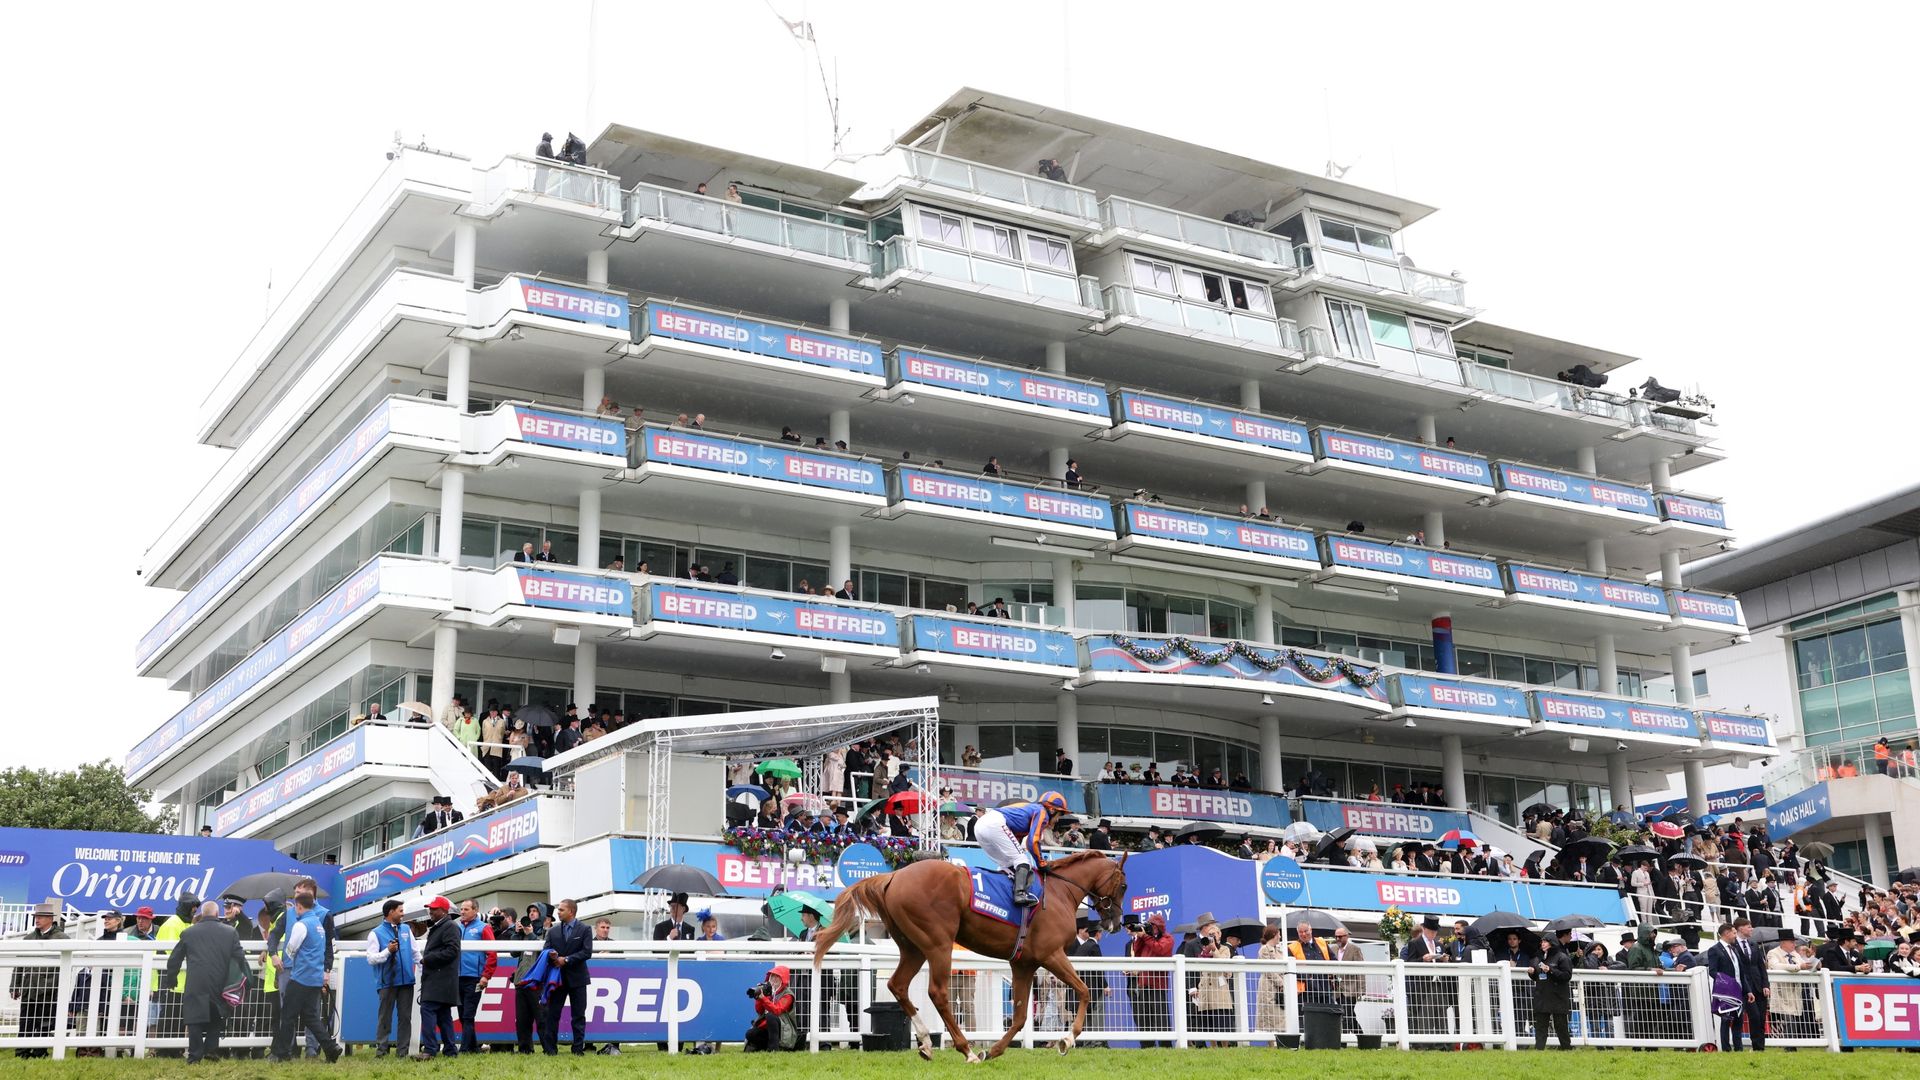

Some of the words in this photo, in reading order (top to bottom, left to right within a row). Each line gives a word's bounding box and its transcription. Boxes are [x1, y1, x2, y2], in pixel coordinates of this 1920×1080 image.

[527, 288, 621, 318] BETFRED
[660, 314, 749, 343] BETFRED
[791, 337, 873, 365] BETFRED
[912, 360, 989, 386] BETFRED
[1025, 381, 1099, 407] BETFRED
[521, 417, 618, 445] BETFRED
[1133, 402, 1203, 426] BETFRED
[1235, 420, 1301, 444] BETFRED
[658, 437, 748, 466] BETFRED
[789, 457, 874, 485] BETFRED
[1332, 437, 1395, 461] BETFRED
[1423, 454, 1483, 478] BETFRED
[913, 478, 992, 503] BETFRED
[1028, 496, 1104, 520] BETFRED
[1510, 471, 1567, 494] BETFRED
[1593, 486, 1648, 508] BETFRED
[1670, 500, 1722, 522] BETFRED
[1138, 513, 1209, 537] BETFRED
[1241, 529, 1308, 551] BETFRED
[1338, 543, 1403, 567] BETFRED
[1432, 558, 1492, 580] BETFRED
[347, 567, 378, 606] BETFRED
[525, 579, 623, 606] BETFRED
[1520, 573, 1578, 594] BETFRED
[1604, 587, 1659, 607] BETFRED
[664, 596, 757, 621] BETFRED
[800, 611, 886, 636] BETFRED
[1680, 597, 1734, 618] BETFRED
[956, 630, 1037, 654] BETFRED
[1433, 685, 1497, 707] BETFRED
[1547, 700, 1606, 720] BETFRED
[1632, 709, 1688, 730] BETFRED
[1711, 719, 1766, 738] BETFRED
[249, 791, 274, 815] BETFRED
[285, 767, 312, 796] BETFRED
[325, 741, 355, 774] BETFRED
[1155, 791, 1253, 818] BETFRED
[1709, 796, 1739, 811] FRED
[1780, 809, 1799, 826] OAKS
[1799, 799, 1817, 820] HALL
[1347, 809, 1434, 833] BETFRED
[75, 847, 119, 861] WELCOME
[120, 850, 130, 861] TO
[132, 850, 147, 863] THE
[148, 851, 173, 864] HOME
[175, 853, 185, 864] OF
[187, 853, 200, 866] THE
[346, 870, 379, 899] BETFRED
[414, 841, 454, 874] BETFRED
[489, 810, 537, 849] BETFRED
[52, 862, 215, 908] Original
[973, 873, 984, 892] 1
[1266, 880, 1301, 890] SECOND
[1381, 884, 1461, 905] BETFRED
[975, 900, 1008, 918] BETFRED
[1133, 894, 1170, 910] BETFRED
[451, 976, 703, 1023] ERED
